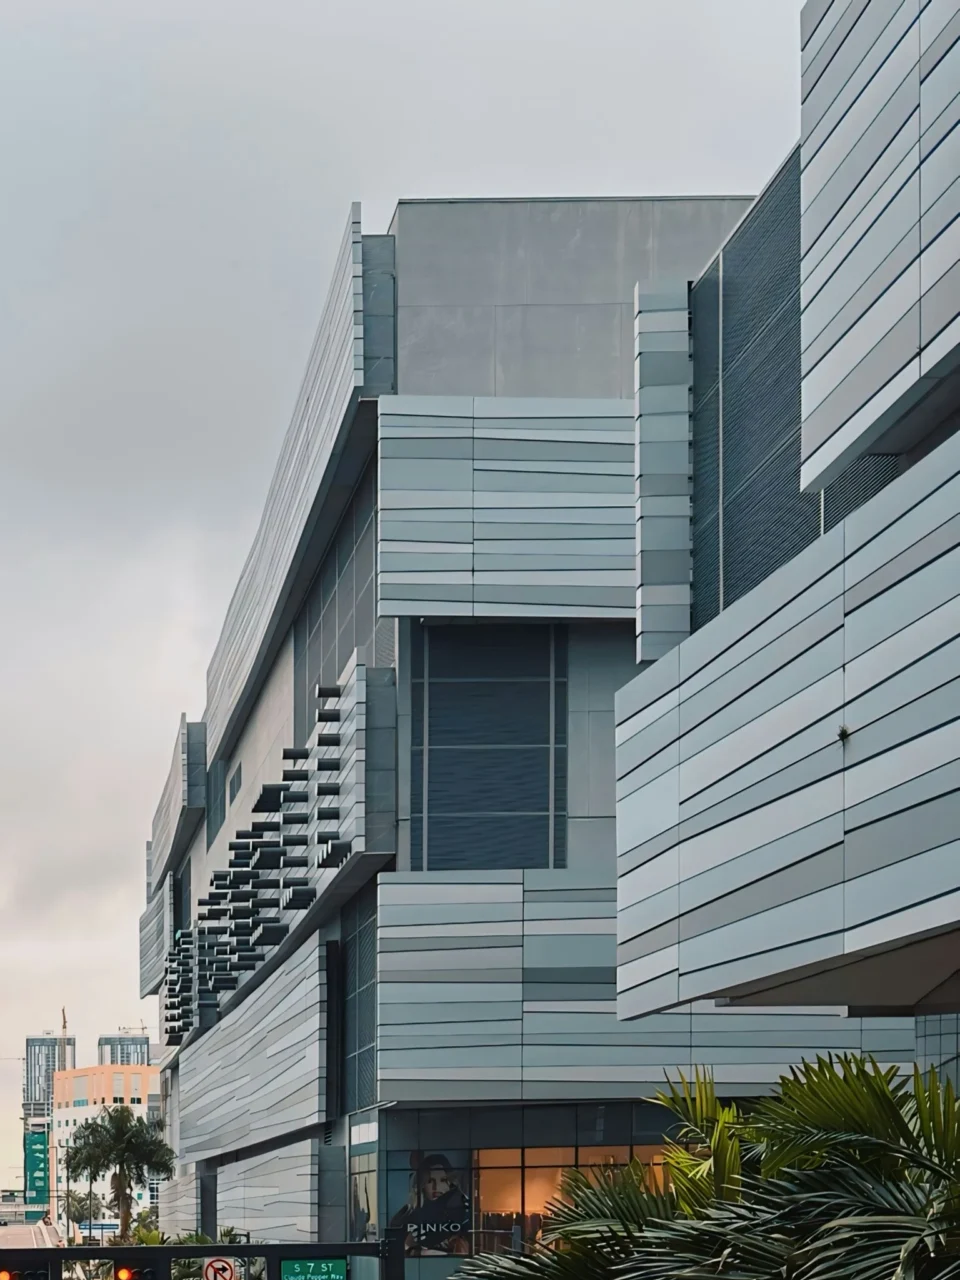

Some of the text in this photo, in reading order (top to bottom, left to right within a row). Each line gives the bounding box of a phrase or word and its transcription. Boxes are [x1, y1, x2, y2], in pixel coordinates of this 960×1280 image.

[407, 1223, 461, 1233] PINKO
[294, 1263, 334, 1273] S 7 ST
